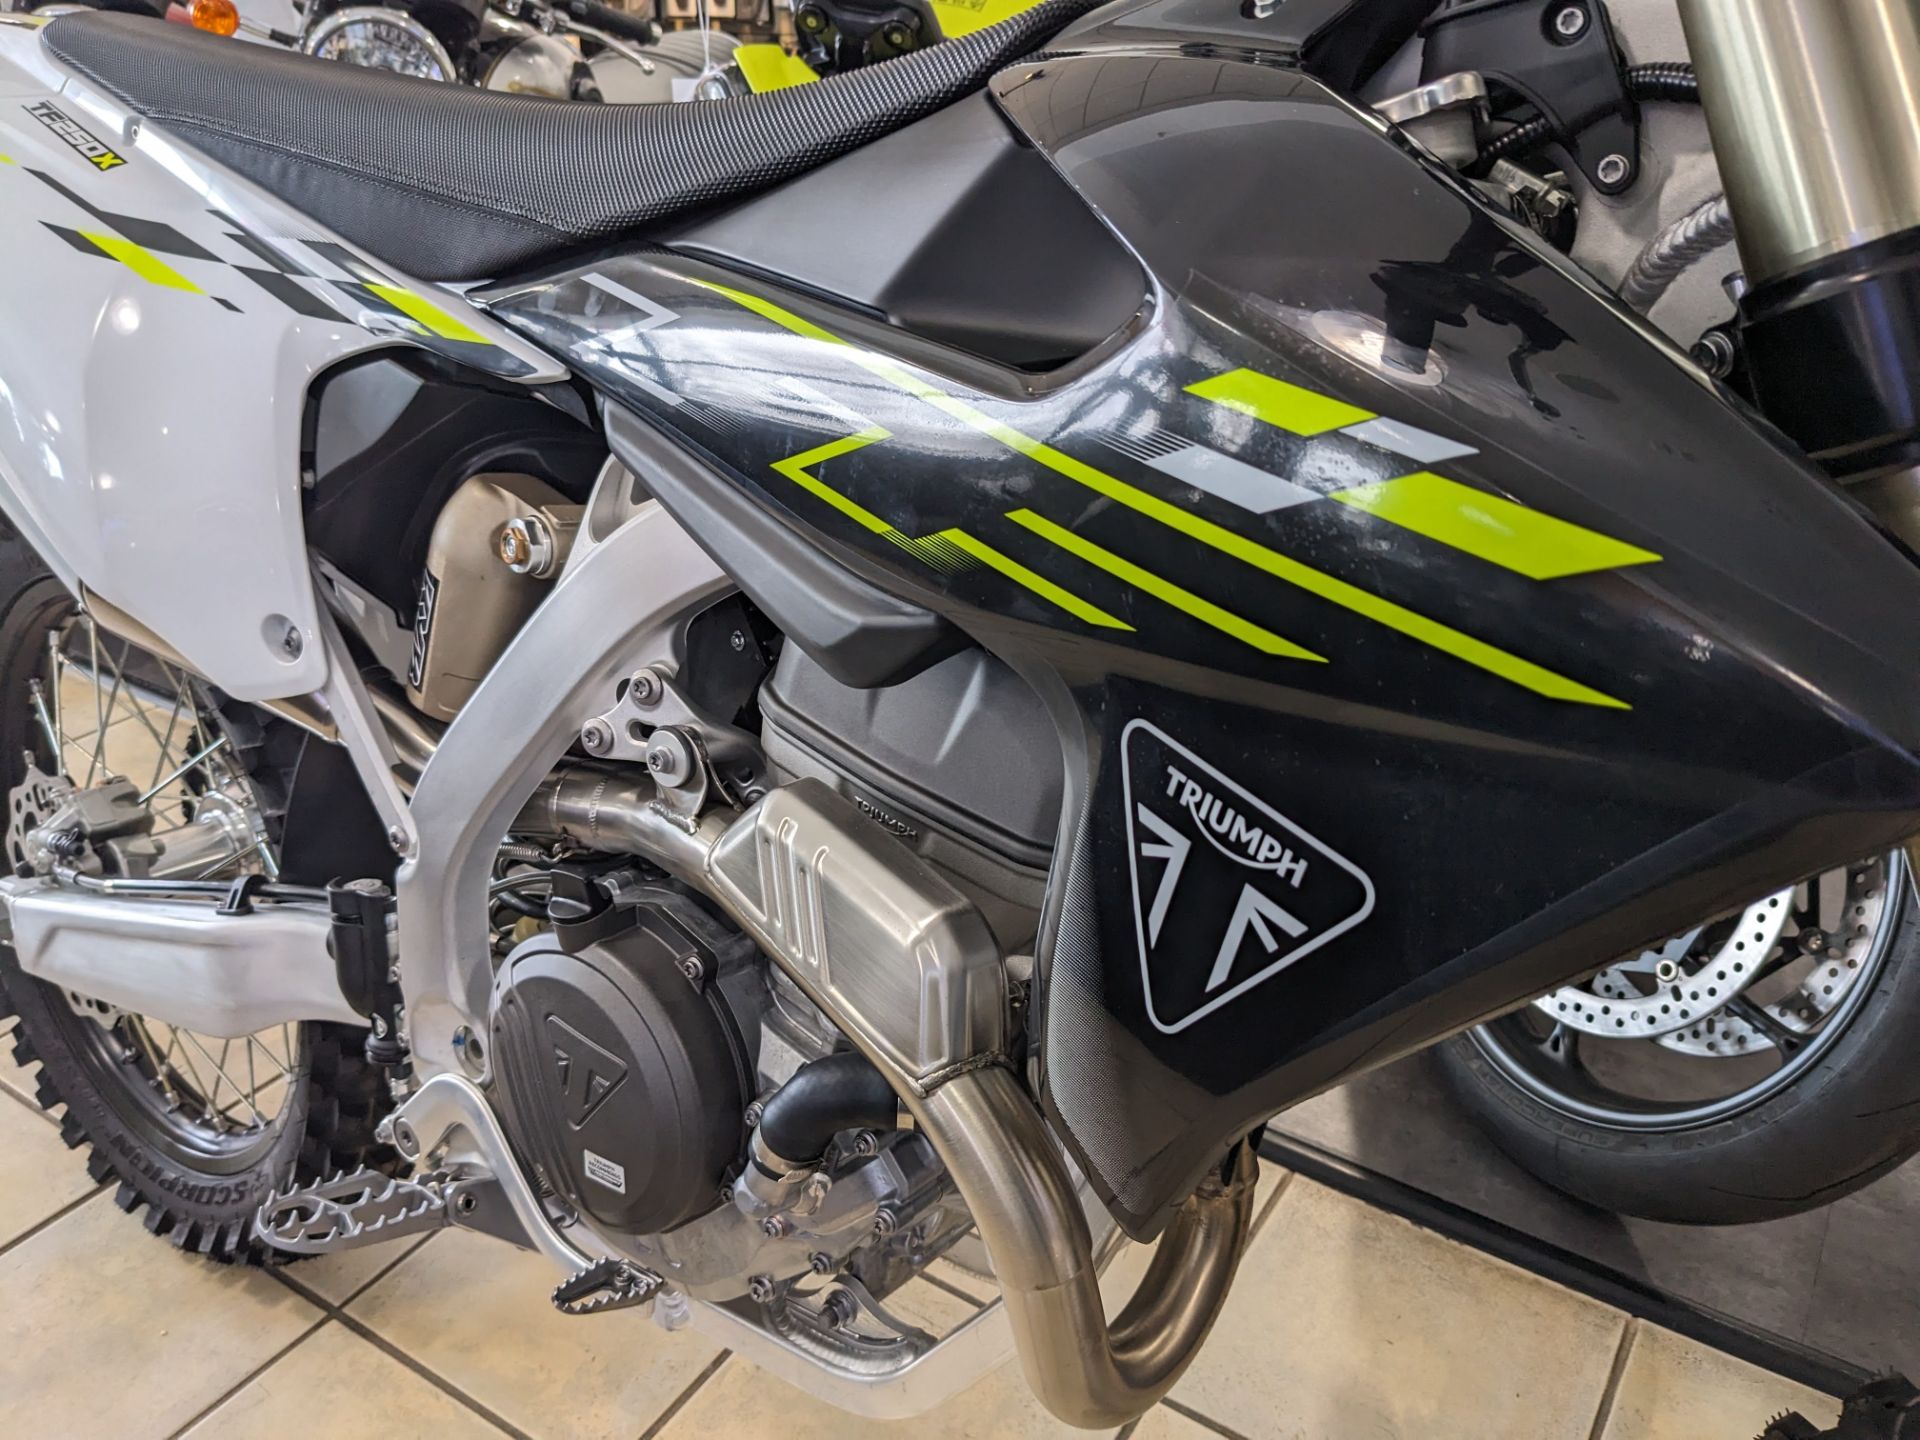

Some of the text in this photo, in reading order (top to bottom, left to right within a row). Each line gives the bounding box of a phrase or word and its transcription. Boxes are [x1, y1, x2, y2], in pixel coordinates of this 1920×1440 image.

[25, 100, 127, 171] TF250X
[854, 795, 919, 842] TRIUMPH
[1166, 764, 1308, 888] TRIUMPH
[108, 1133, 249, 1206] SCORPION
